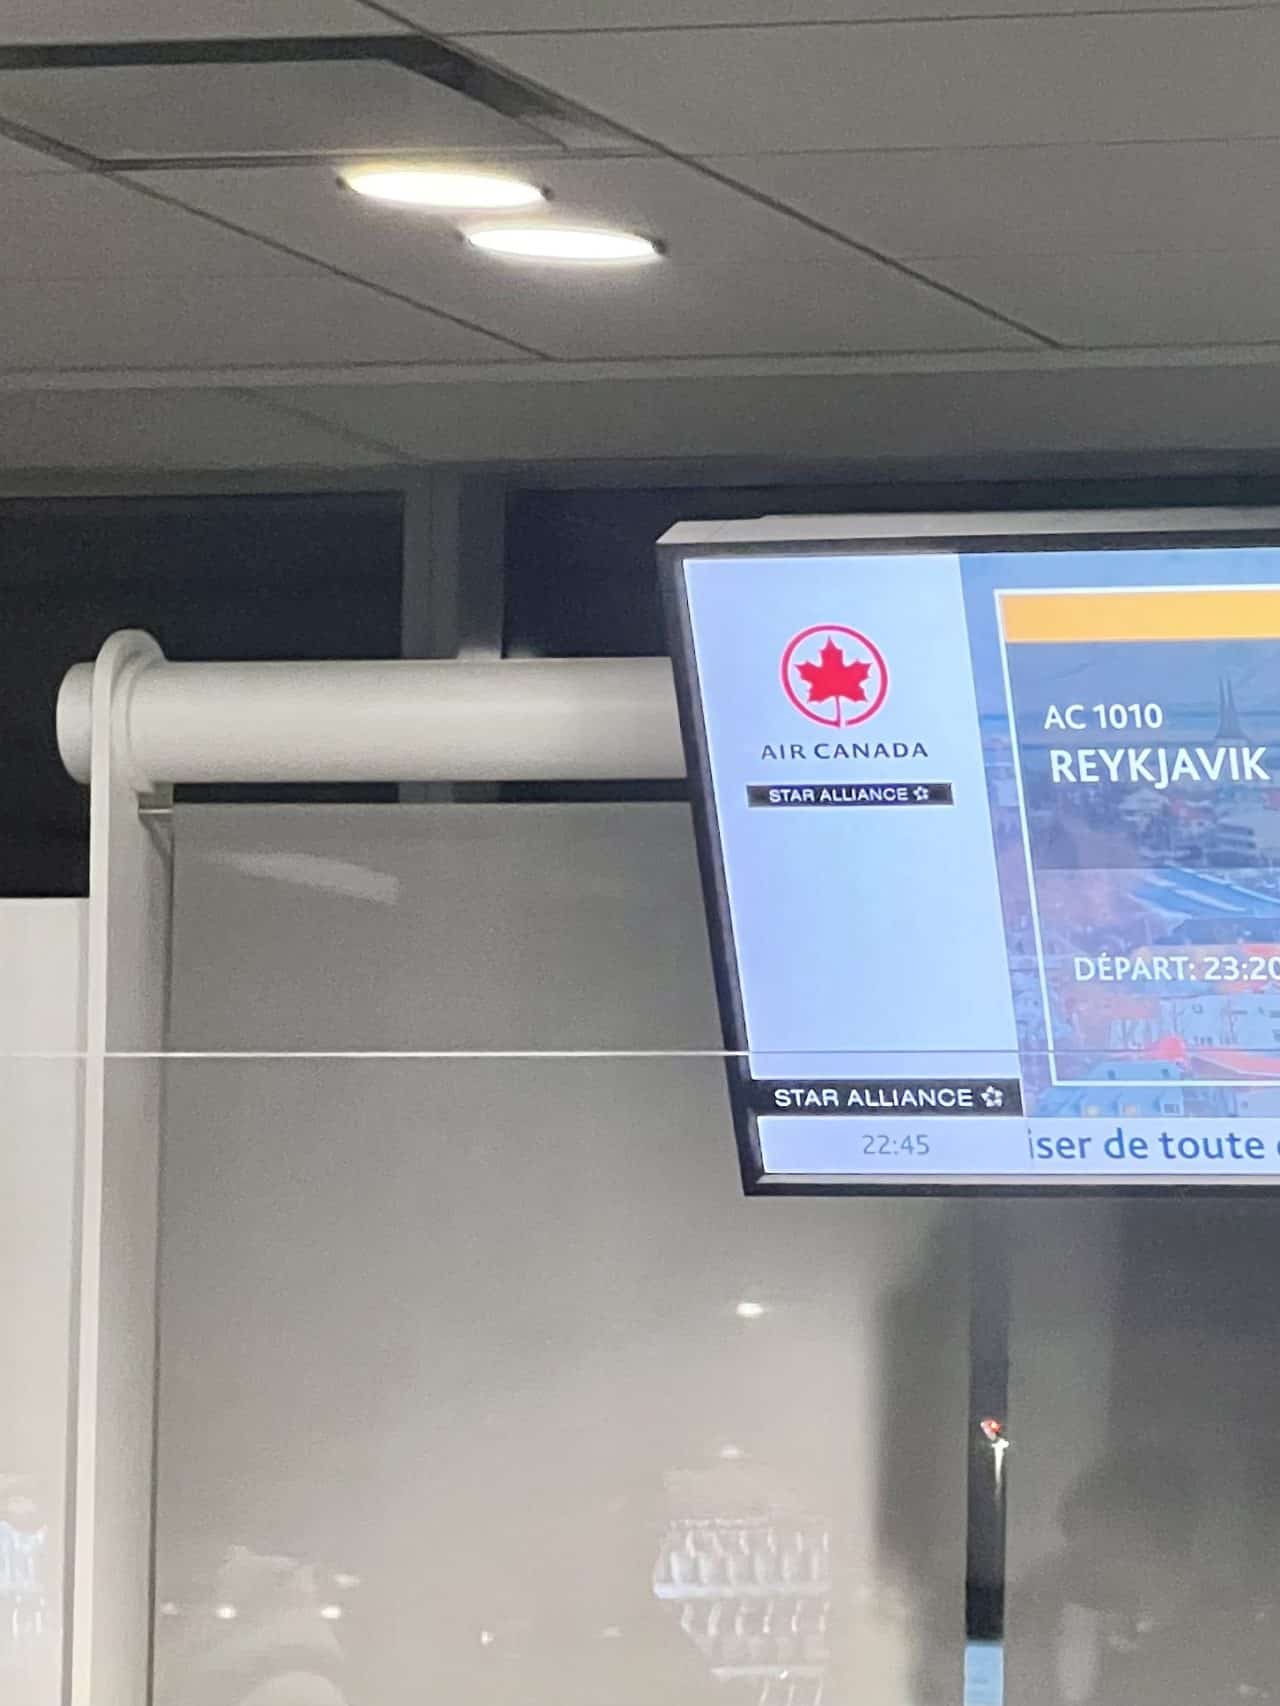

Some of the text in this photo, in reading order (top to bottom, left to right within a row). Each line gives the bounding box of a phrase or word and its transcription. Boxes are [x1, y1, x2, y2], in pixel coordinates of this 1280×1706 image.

[1044, 703, 1163, 730] AC 1010
[761, 741, 929, 760] AIR CANADA
[1050, 747, 1270, 789] REYKJAVIK
[769, 786, 909, 802] STAR ALLIANCE
[1073, 952, 1197, 982] DÉPART:
[774, 1087, 973, 1107] STAR ALLIANCE
[862, 1135, 930, 1155] 22:45
[1104, 1127, 1148, 1160] de
[1161, 1131, 1265, 1160] toute
